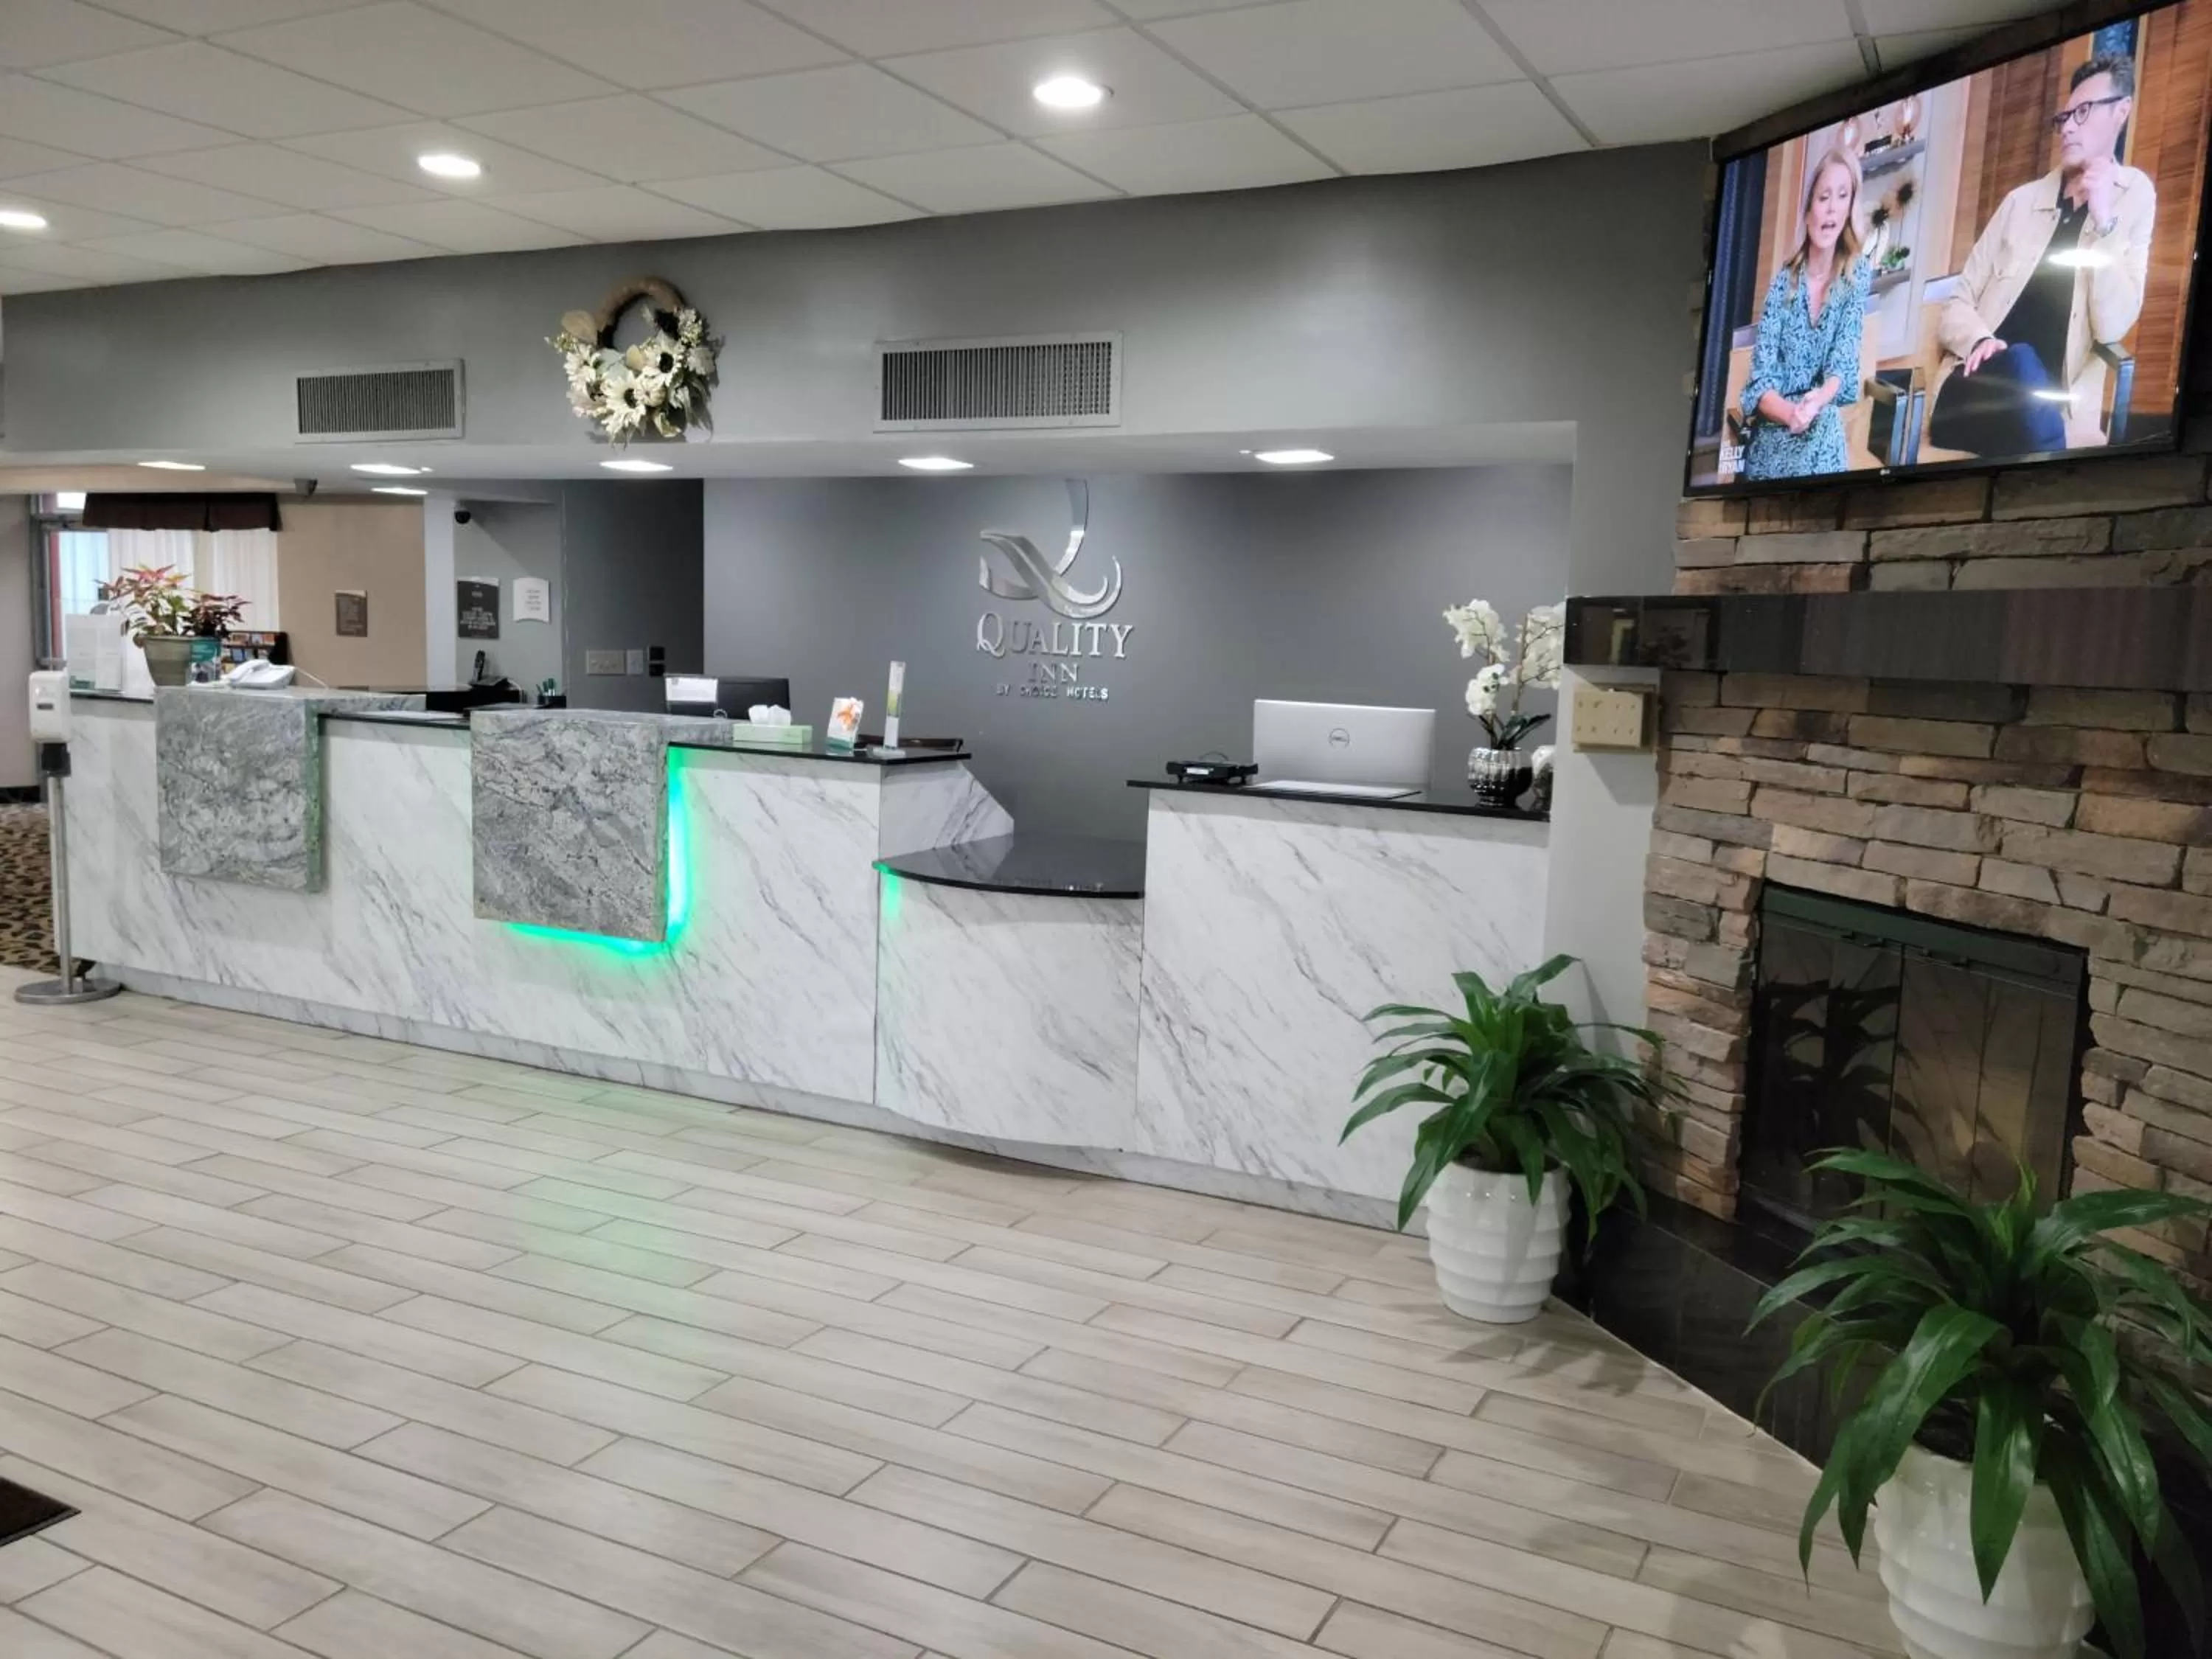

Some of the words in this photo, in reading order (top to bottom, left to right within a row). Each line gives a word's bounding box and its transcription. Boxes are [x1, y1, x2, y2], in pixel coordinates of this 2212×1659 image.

[975, 611, 1134, 658] QUALITY
[1028, 661, 1079, 684] INN
[1066, 686, 1110, 700] HOTELS
